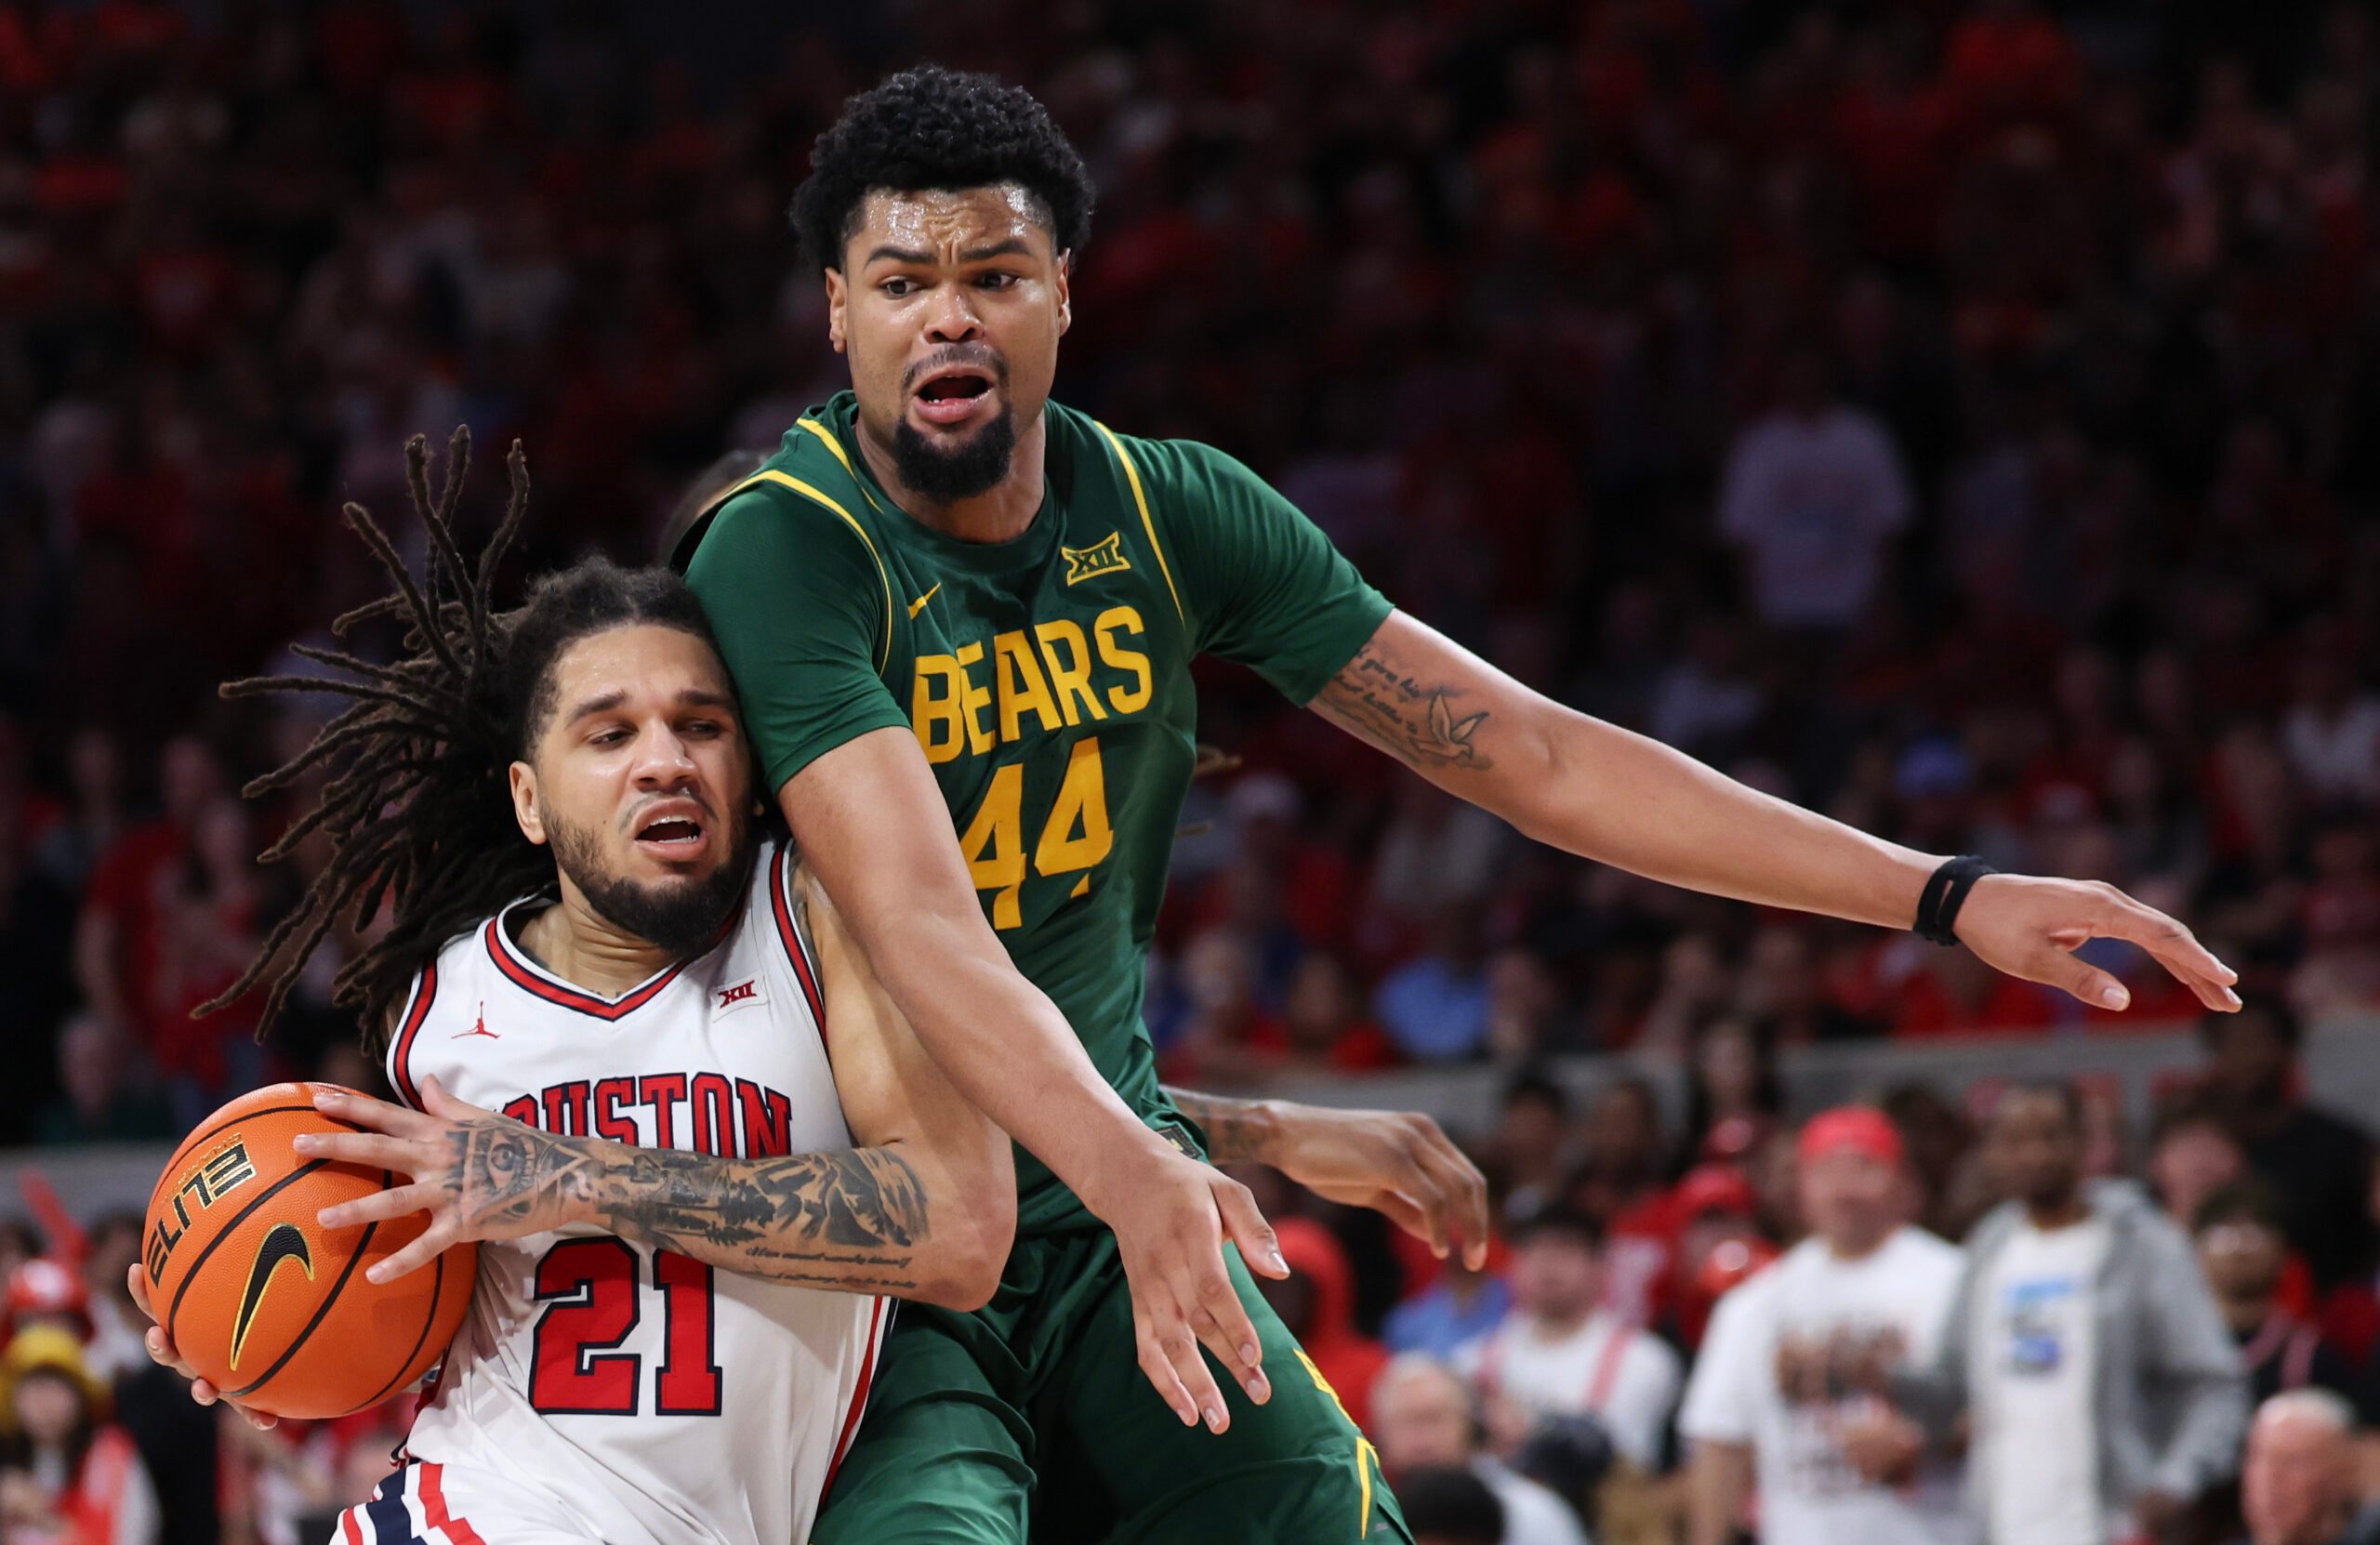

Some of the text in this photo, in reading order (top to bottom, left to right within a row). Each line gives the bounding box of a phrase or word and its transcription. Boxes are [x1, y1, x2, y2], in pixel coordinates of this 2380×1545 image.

[912, 605, 1153, 764] BEARS
[959, 735, 1114, 931] 44
[717, 979, 758, 1010] XII
[146, 1141, 257, 1289] ELITE
[528, 1235, 722, 1417] 21
